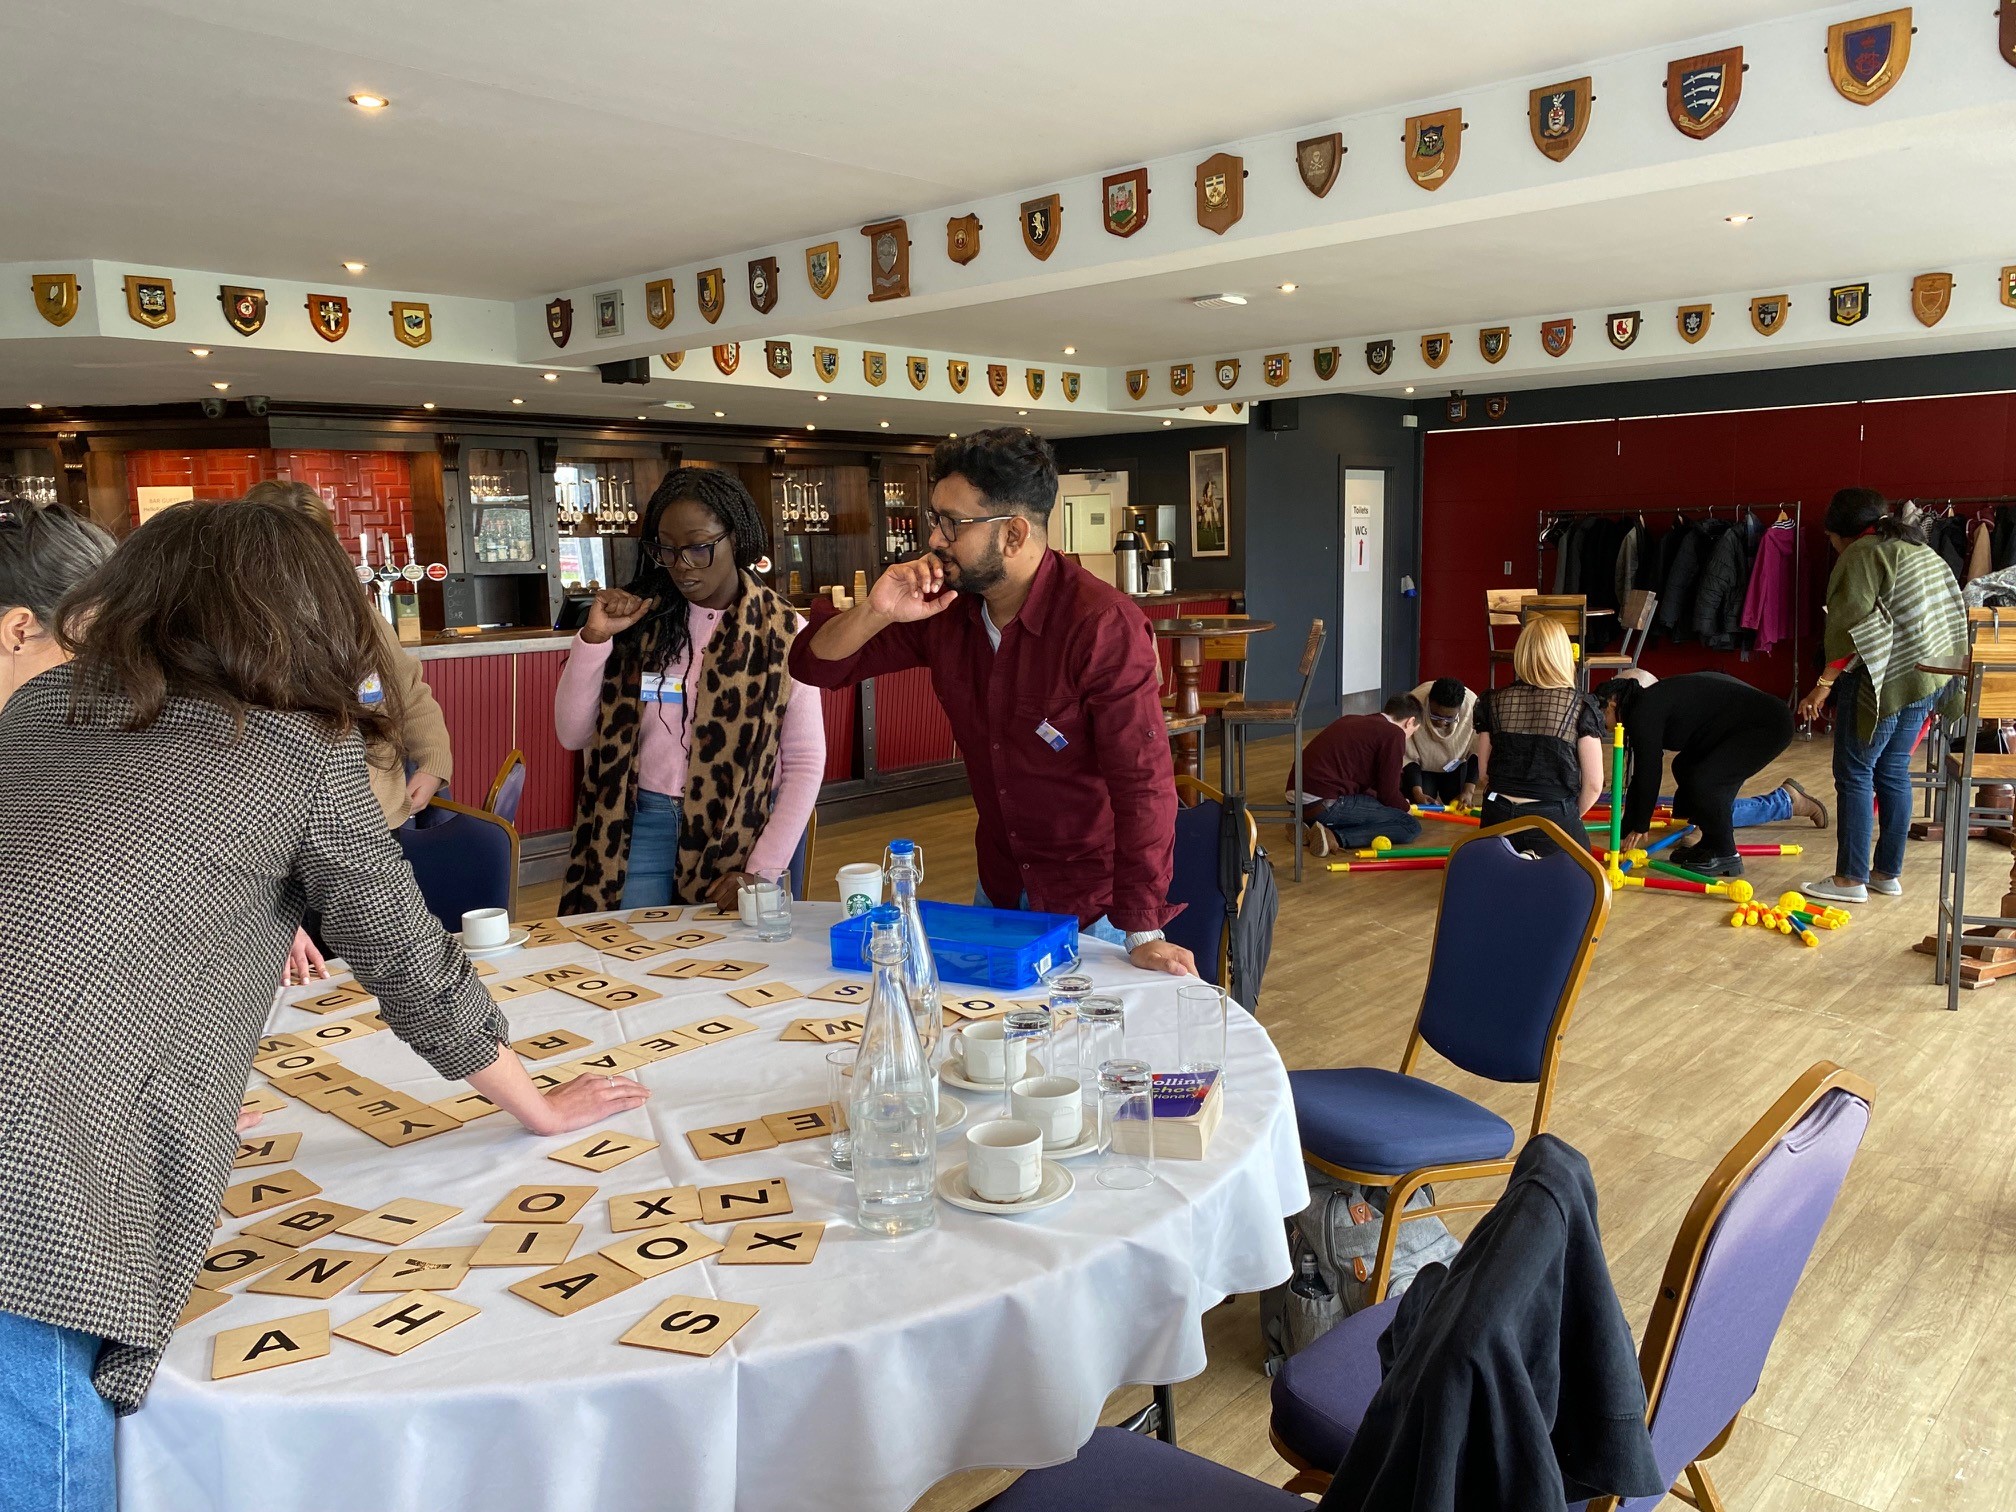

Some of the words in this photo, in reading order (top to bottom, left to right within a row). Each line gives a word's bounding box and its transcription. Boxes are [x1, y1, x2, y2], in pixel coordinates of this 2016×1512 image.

[1353, 506, 1369, 515] Toilets
[1354, 526, 1368, 536] WCs
[522, 922, 547, 932] X
[676, 934, 705, 942] C
[675, 964, 696, 972] I
[545, 970, 583, 982] W
[577, 981, 608, 990] O
[835, 986, 863, 995] S
[316, 995, 353, 1006] U
[606, 991, 638, 1001] C
[958, 1000, 995, 1010] Q
[316, 1027, 351, 1038] O
[697, 1022, 733, 1034] D
[530, 1037, 569, 1049] R
[639, 1039, 679, 1051] E
[277, 1056, 314, 1068] O
[581, 1055, 617, 1068] A
[294, 1072, 332, 1081] L
[324, 1086, 363, 1096] L
[358, 1100, 400, 1116] E
[787, 1113, 825, 1130] E
[399, 1120, 436, 1136] Y
[709, 1127, 746, 1145] A
[235, 1141, 275, 1159] K
[584, 1140, 630, 1158] V
[252, 1184, 291, 1203] V
[518, 1193, 565, 1212] O
[634, 1196, 676, 1220] X
[278, 1211, 334, 1231] B
[379, 1214, 417, 1224] I
[517, 1232, 538, 1253] I
[747, 1232, 803, 1250] X
[637, 1238, 688, 1259] O
[203, 1250, 265, 1272] Q
[539, 1273, 598, 1300] A
[373, 1304, 445, 1335] H
[661, 1311, 719, 1334] S
[243, 1330, 300, 1361] A
